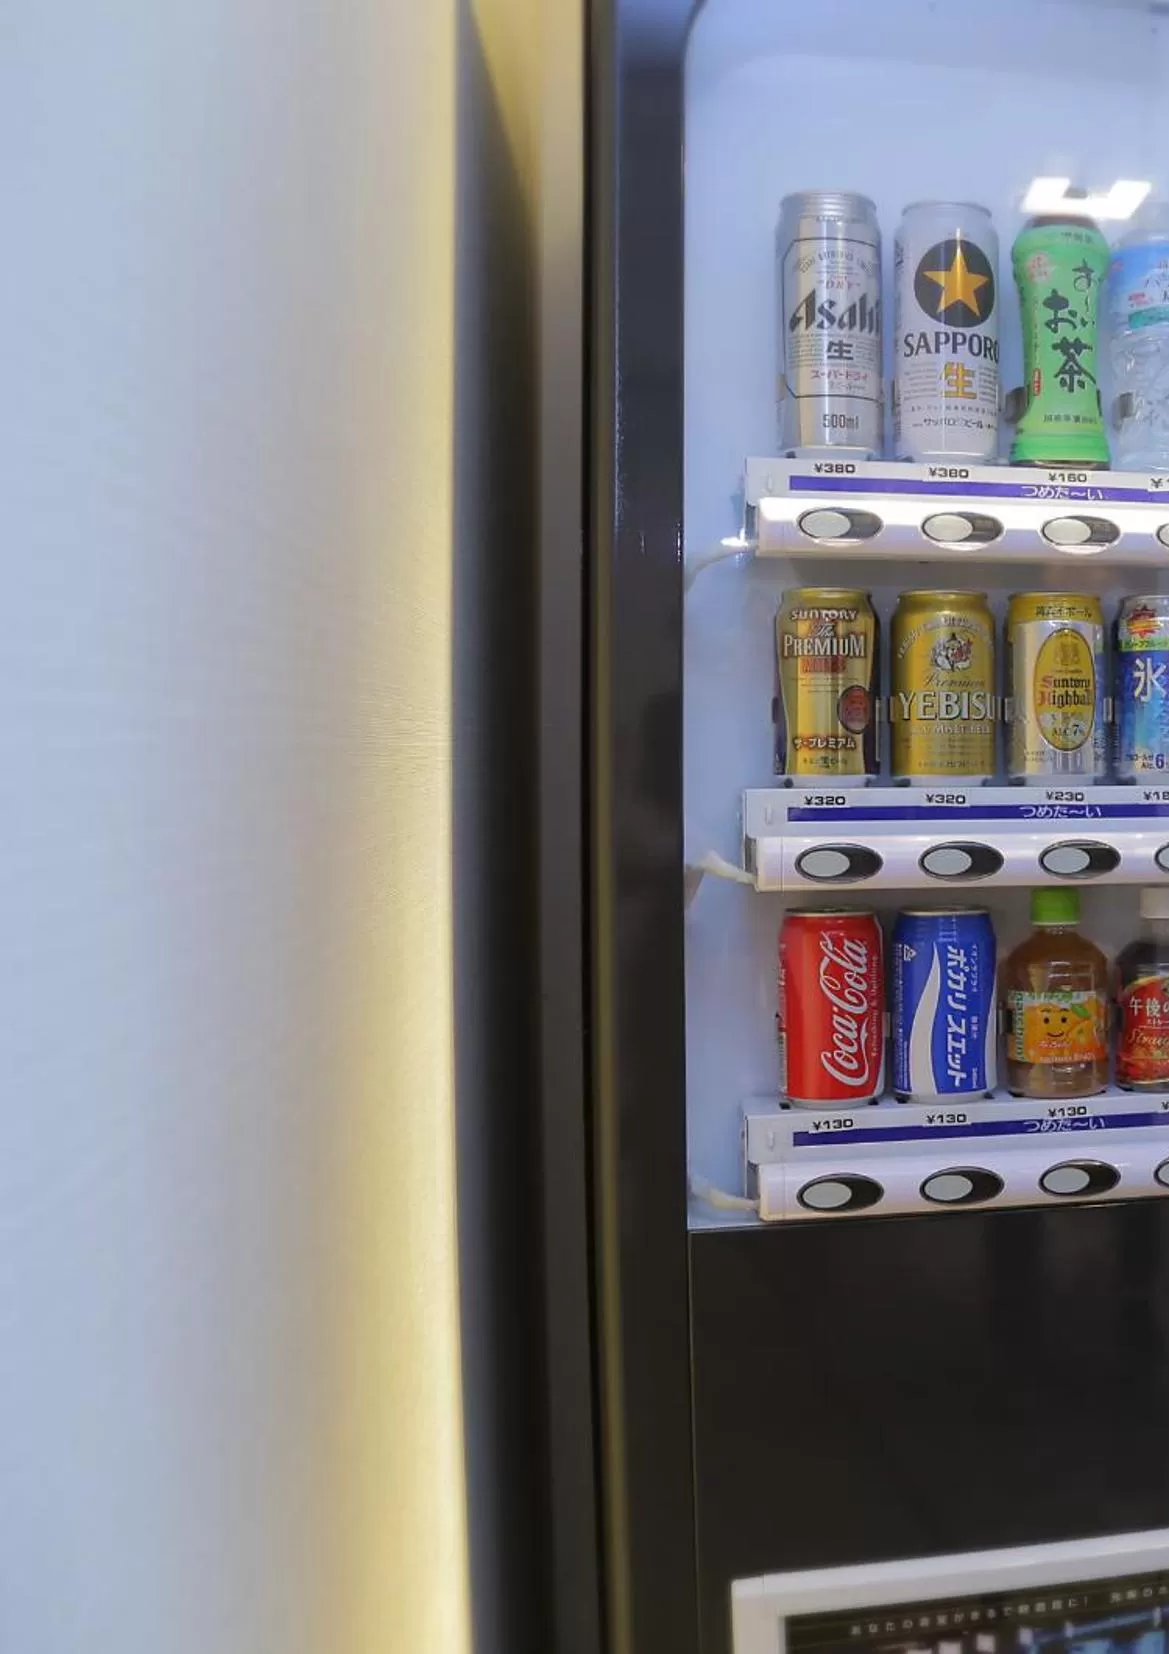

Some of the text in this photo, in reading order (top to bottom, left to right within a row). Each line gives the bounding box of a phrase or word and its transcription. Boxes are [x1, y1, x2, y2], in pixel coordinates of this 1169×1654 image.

[789, 288, 881, 335] Asahi
[903, 331, 999, 364] SAPPORO
[1043, 288, 1097, 393] お茶
[827, 340, 854, 361] 生
[940, 361, 977, 400] 生
[823, 414, 859, 429] 500ml
[814, 463, 856, 474] ¥380
[929, 468, 969, 479] ¥380
[791, 609, 858, 621] SUNTORY
[784, 635, 865, 656] PREMIUM
[899, 691, 995, 721] YEBISU
[804, 795, 846, 806] ¥320
[926, 794, 966, 804] ¥320
[1046, 790, 1084, 801] ¥230
[820, 931, 870, 1087] Coca-Cola
[946, 945, 968, 1088] ポカリスエット
[926, 1114, 967, 1125] ¥130
[1048, 1106, 1087, 1118] ¥130
[813, 1119, 853, 1130] ¥130
